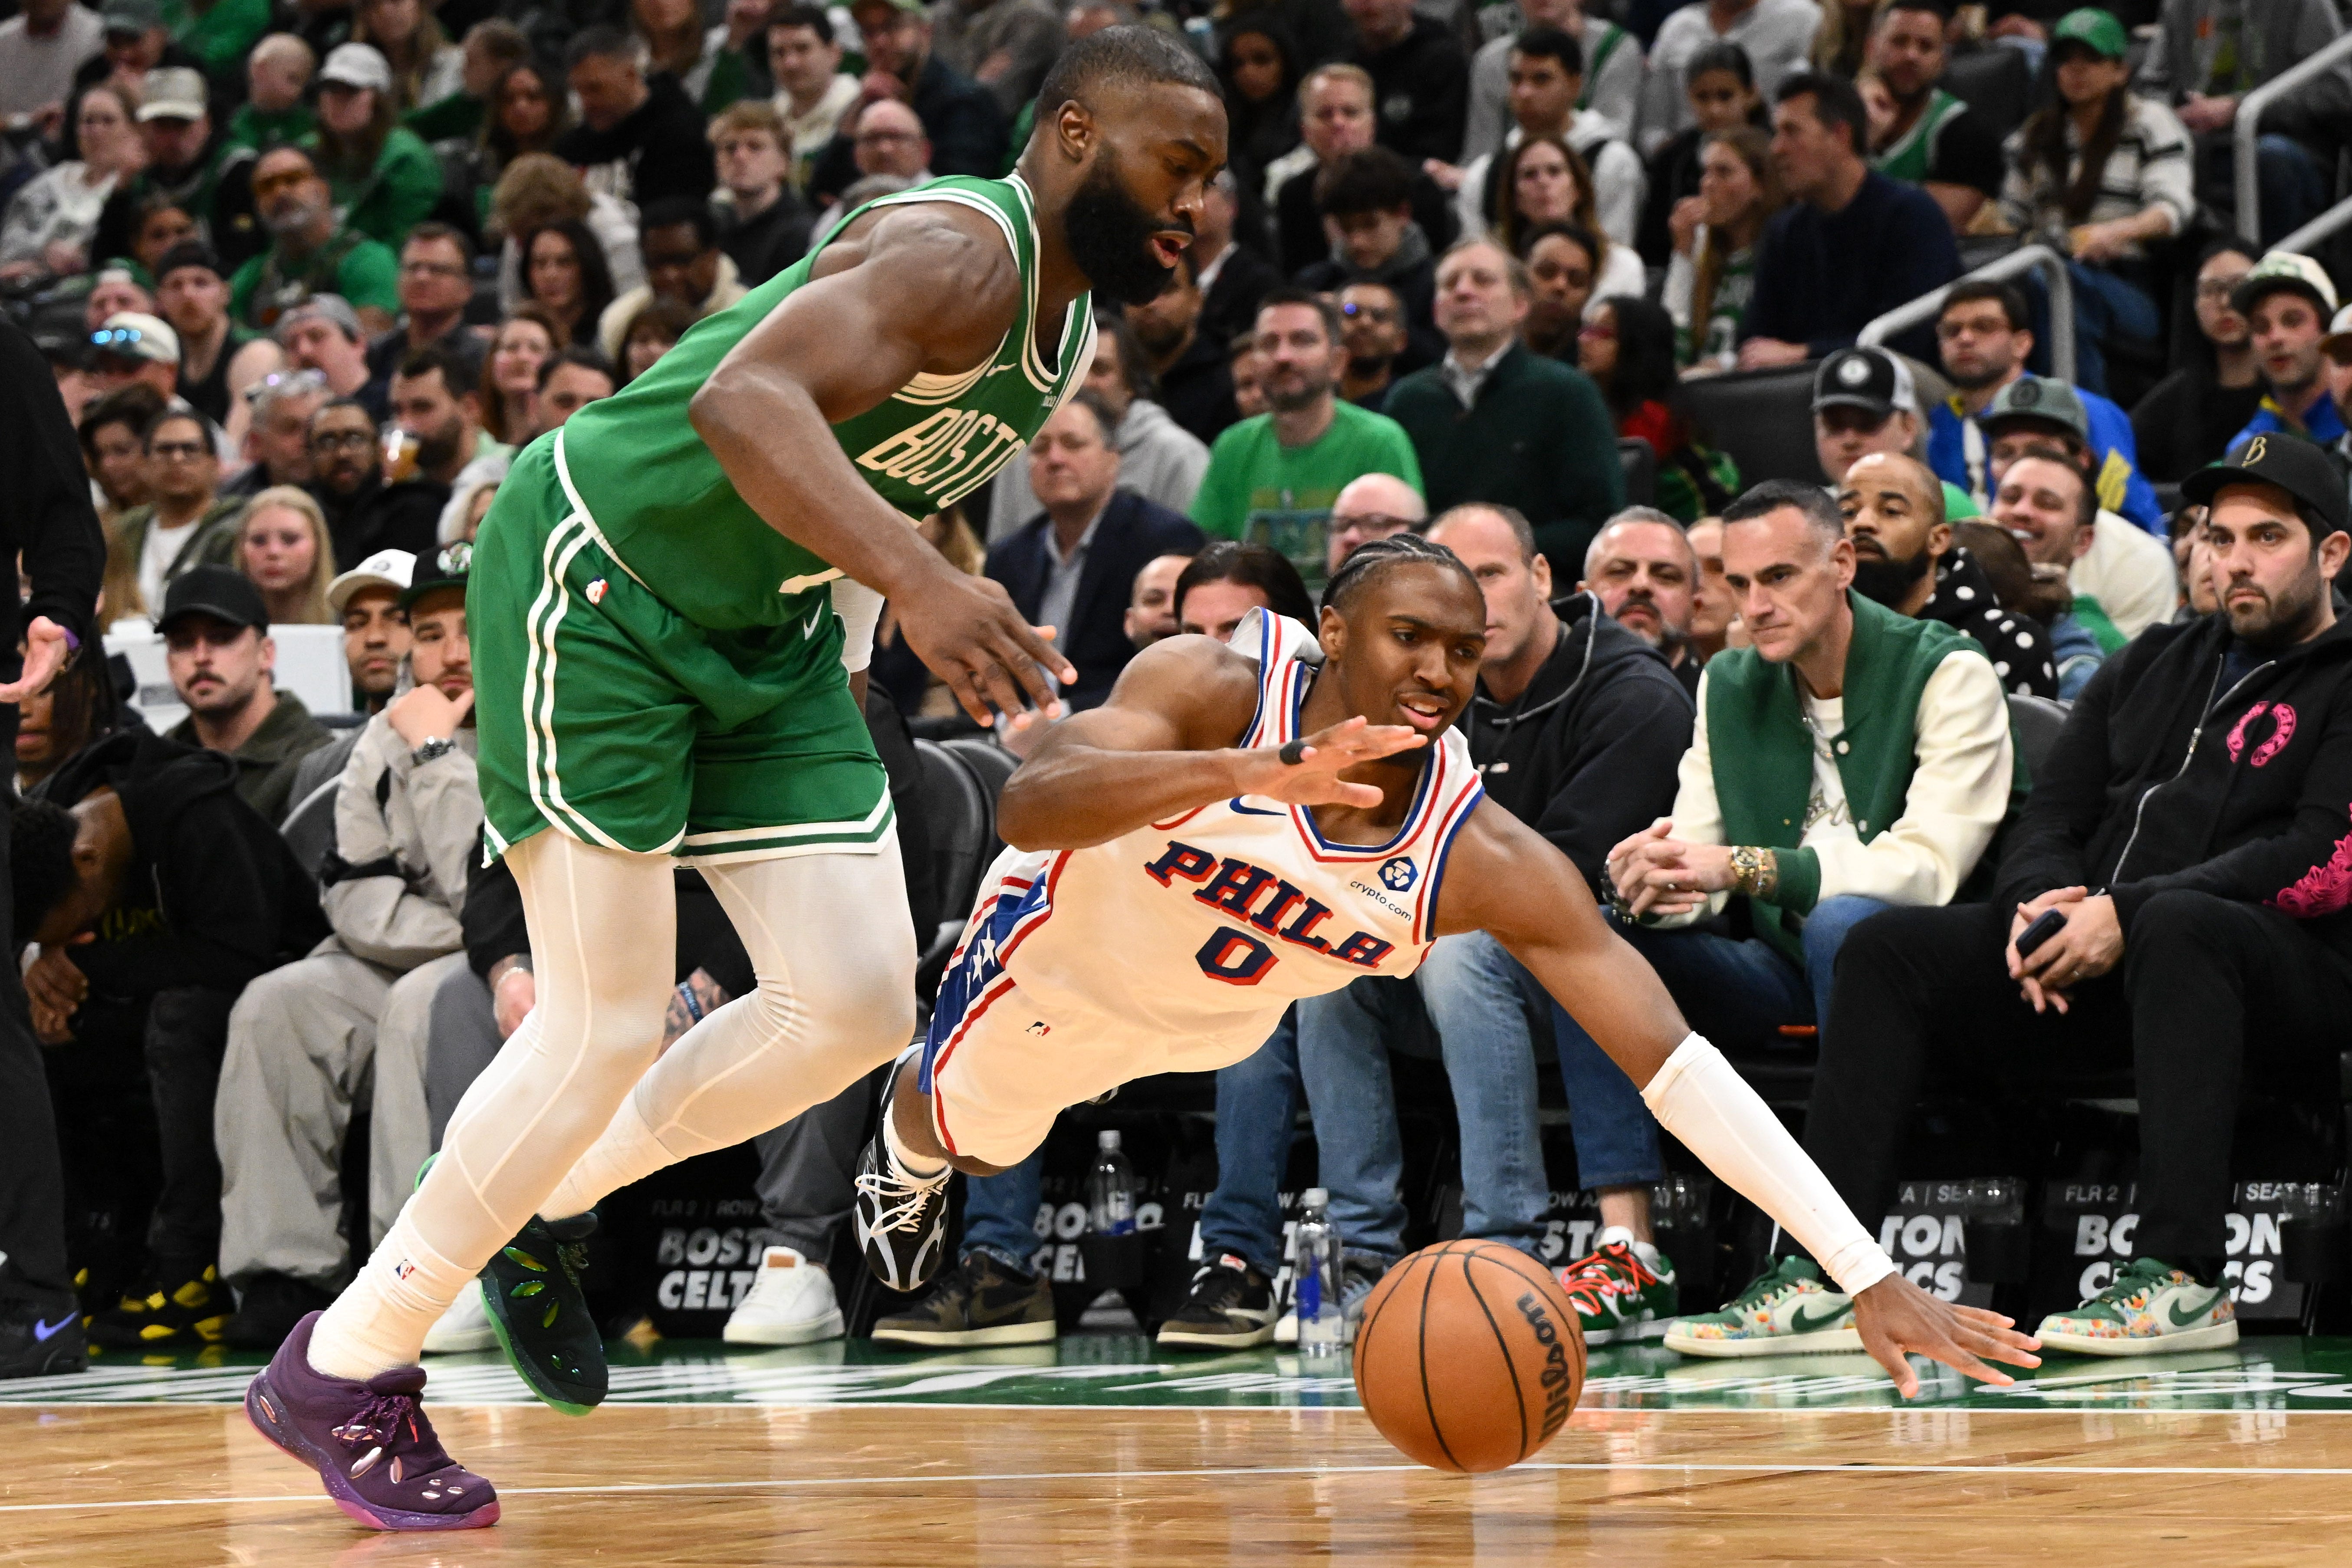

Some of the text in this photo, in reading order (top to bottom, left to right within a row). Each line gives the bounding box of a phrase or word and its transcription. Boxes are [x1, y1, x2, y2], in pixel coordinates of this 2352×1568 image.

[854, 407, 1026, 510] BOSTO
[1144, 840, 1395, 969] PHILA
[1350, 881, 1411, 921] crypto.com
[1195, 926, 1280, 986] 0
[2066, 1184, 2102, 1202] FLR
[2106, 1184, 2119, 1202] 2
[657, 1227, 766, 1267] BOST
[1879, 1214, 1966, 1257] TON
[2074, 1213, 2289, 1257] BOON
[657, 1270, 756, 1309] CELT
[1516, 1289, 1571, 1442] Wilson
